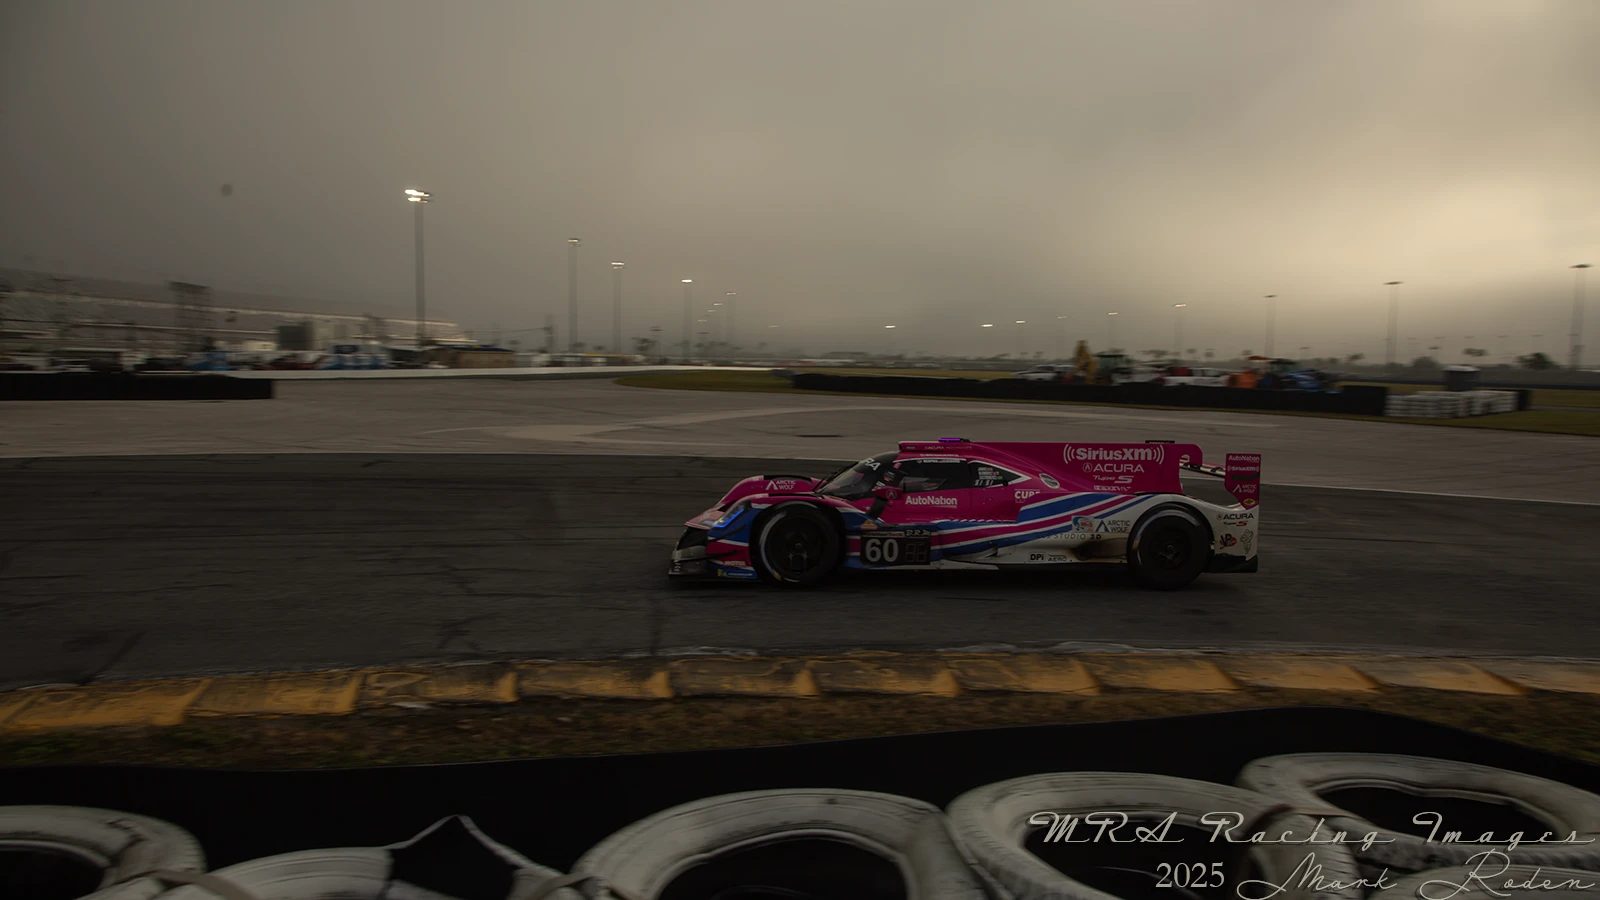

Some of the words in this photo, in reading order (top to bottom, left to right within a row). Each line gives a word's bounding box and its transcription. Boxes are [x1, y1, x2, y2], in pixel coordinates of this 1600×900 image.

[1075, 447, 1153, 461] SiriusXM
[1093, 463, 1145, 473] ACURA
[1114, 475, 1135, 484] S
[905, 496, 958, 505] AutoNation
[865, 538, 899, 563] 60
[1030, 553, 1044, 561] DPi
